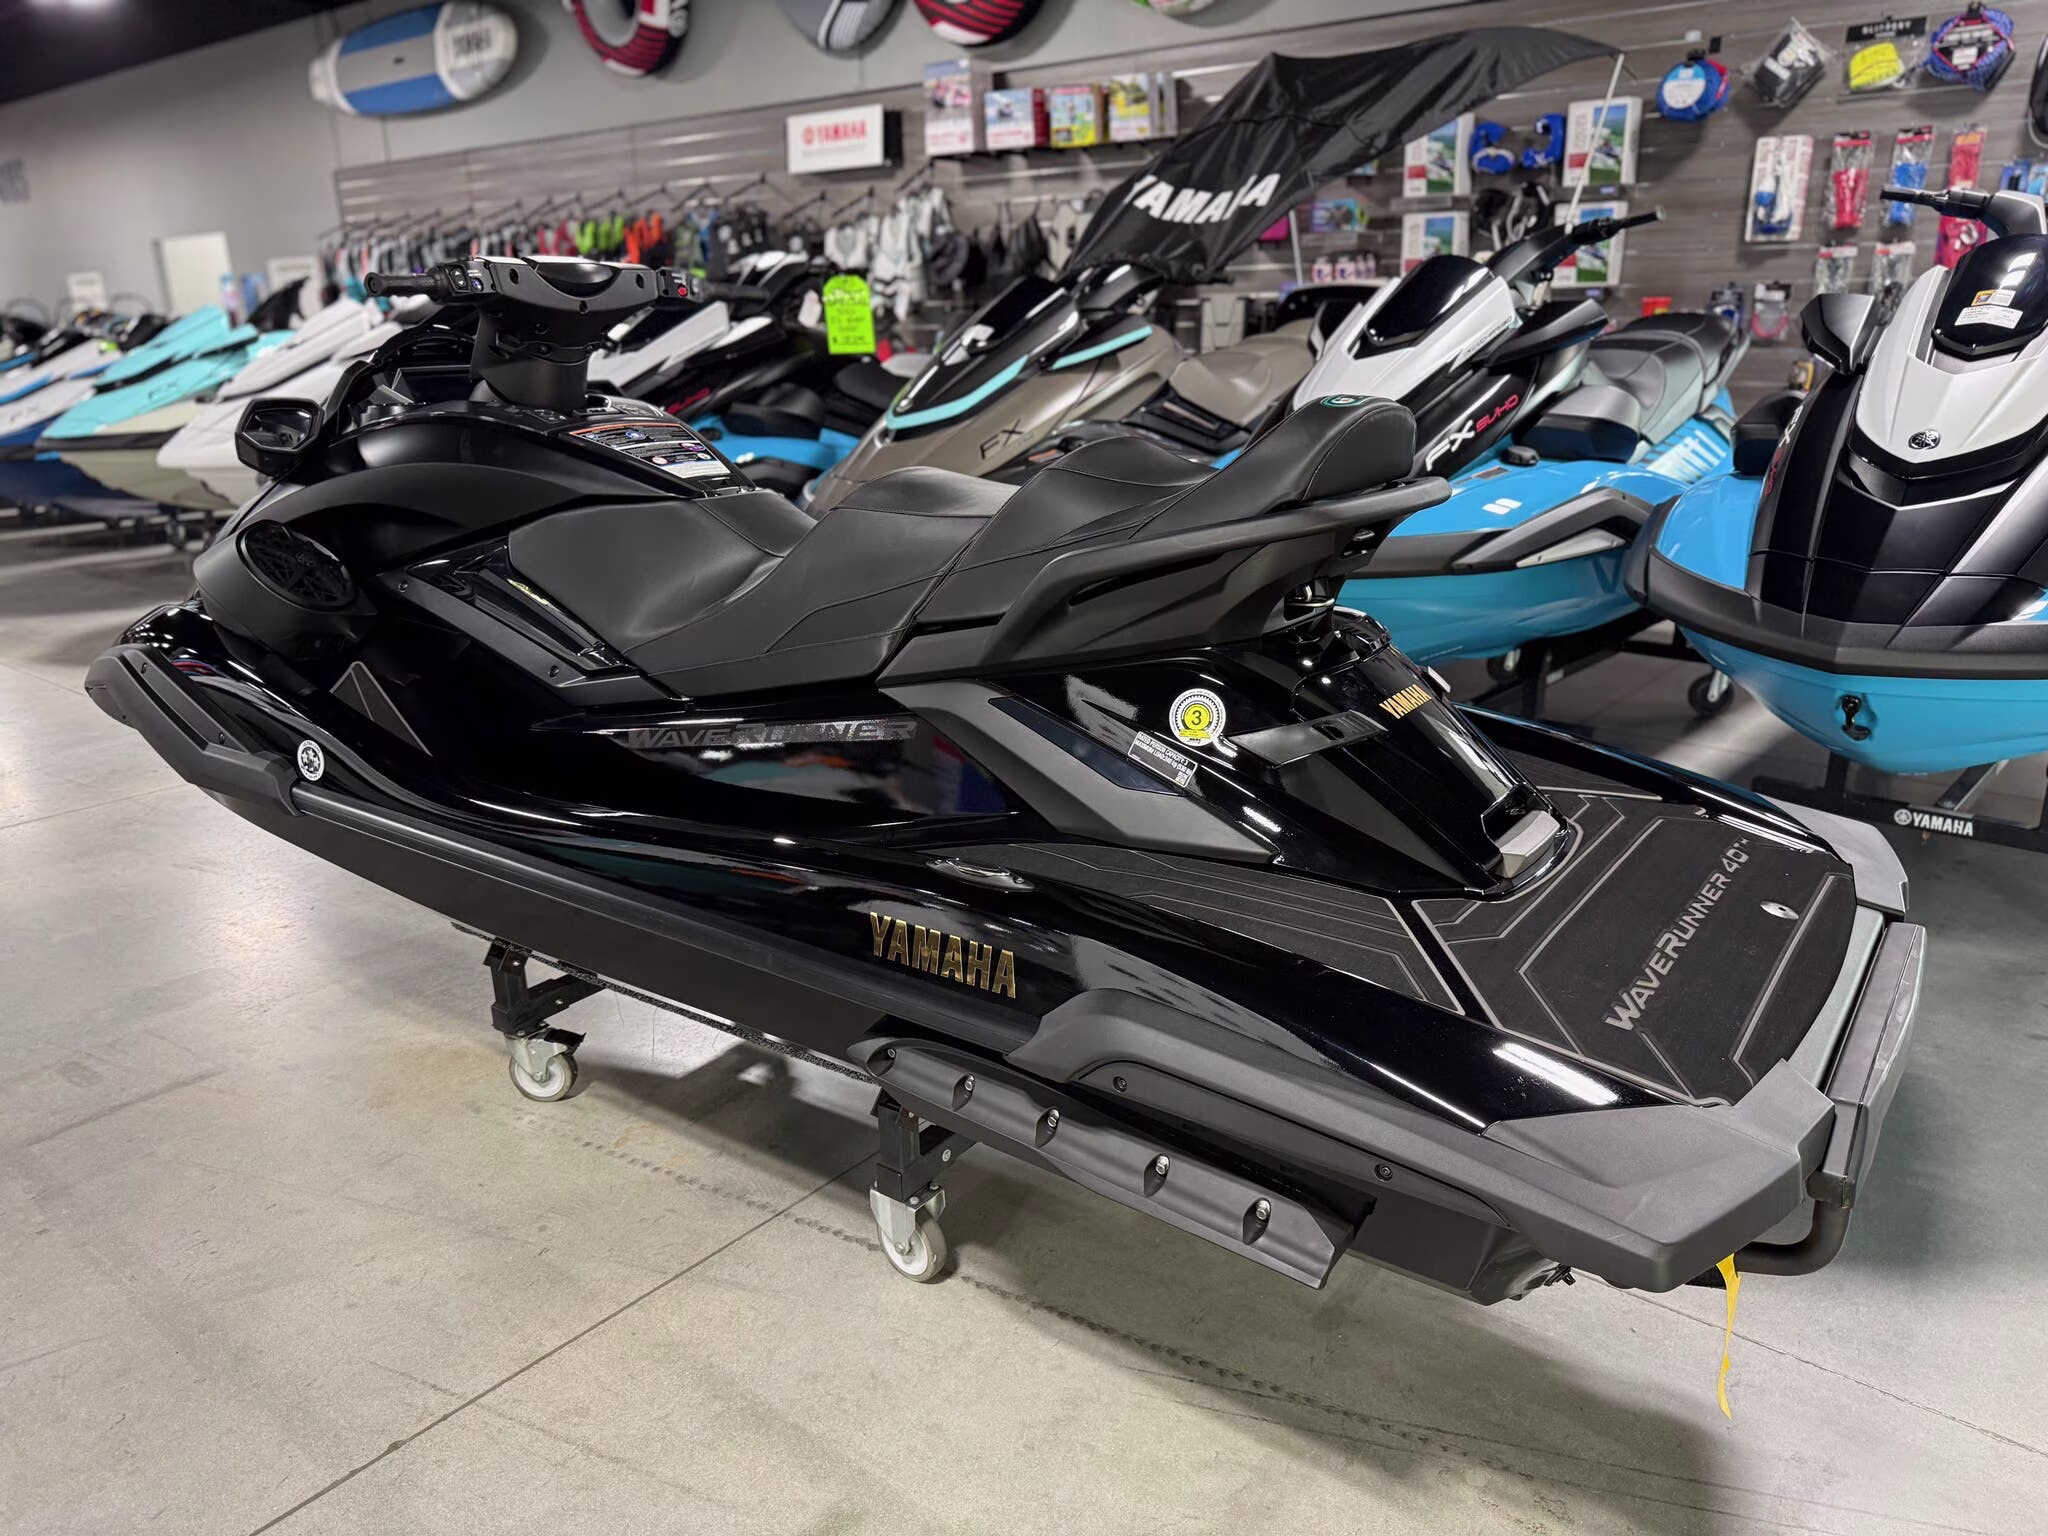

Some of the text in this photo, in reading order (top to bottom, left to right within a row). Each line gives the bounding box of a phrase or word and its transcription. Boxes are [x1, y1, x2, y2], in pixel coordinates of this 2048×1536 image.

[980, 419, 1024, 460] FX
[1425, 419, 1475, 471] FX
[1779, 405, 1803, 448] FX
[1191, 709, 1203, 726] 3
[1378, 684, 1433, 719] YAMAHA
[1912, 811, 1974, 837] YAMAHA
[870, 911, 1016, 999] YAMAHA
[1605, 872, 1722, 1031] WAVERUNNER
